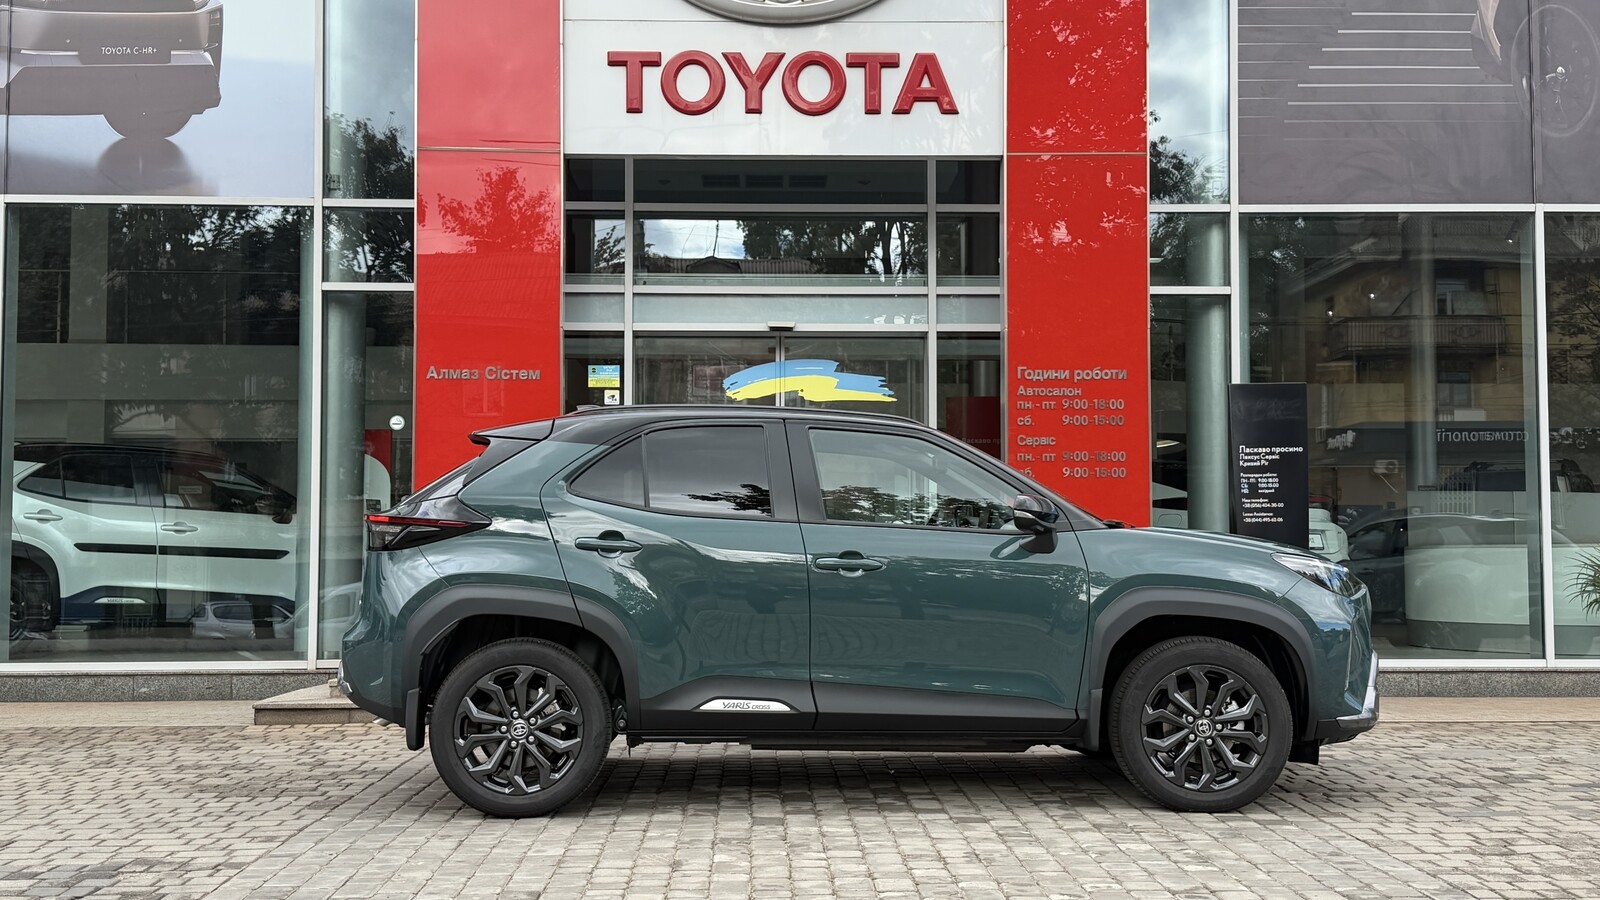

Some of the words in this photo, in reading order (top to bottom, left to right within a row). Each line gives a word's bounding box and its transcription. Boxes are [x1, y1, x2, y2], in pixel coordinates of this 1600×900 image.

[101, 46, 131, 55] TOYOTA
[133, 46, 157, 55] C-HR+
[607, 50, 959, 116] TOYOTA
[426, 366, 479, 380] Алмаз
[485, 365, 541, 380] Сістем
[1017, 366, 1070, 381] Години
[1074, 366, 1127, 382] роботи
[1017, 385, 1082, 396] Автосалон
[1017, 415, 1035, 426] сб.
[1017, 435, 1056, 447] Сервіс
[1239, 445, 1271, 453] Ласкаво
[1271, 446, 1304, 454] просимо
